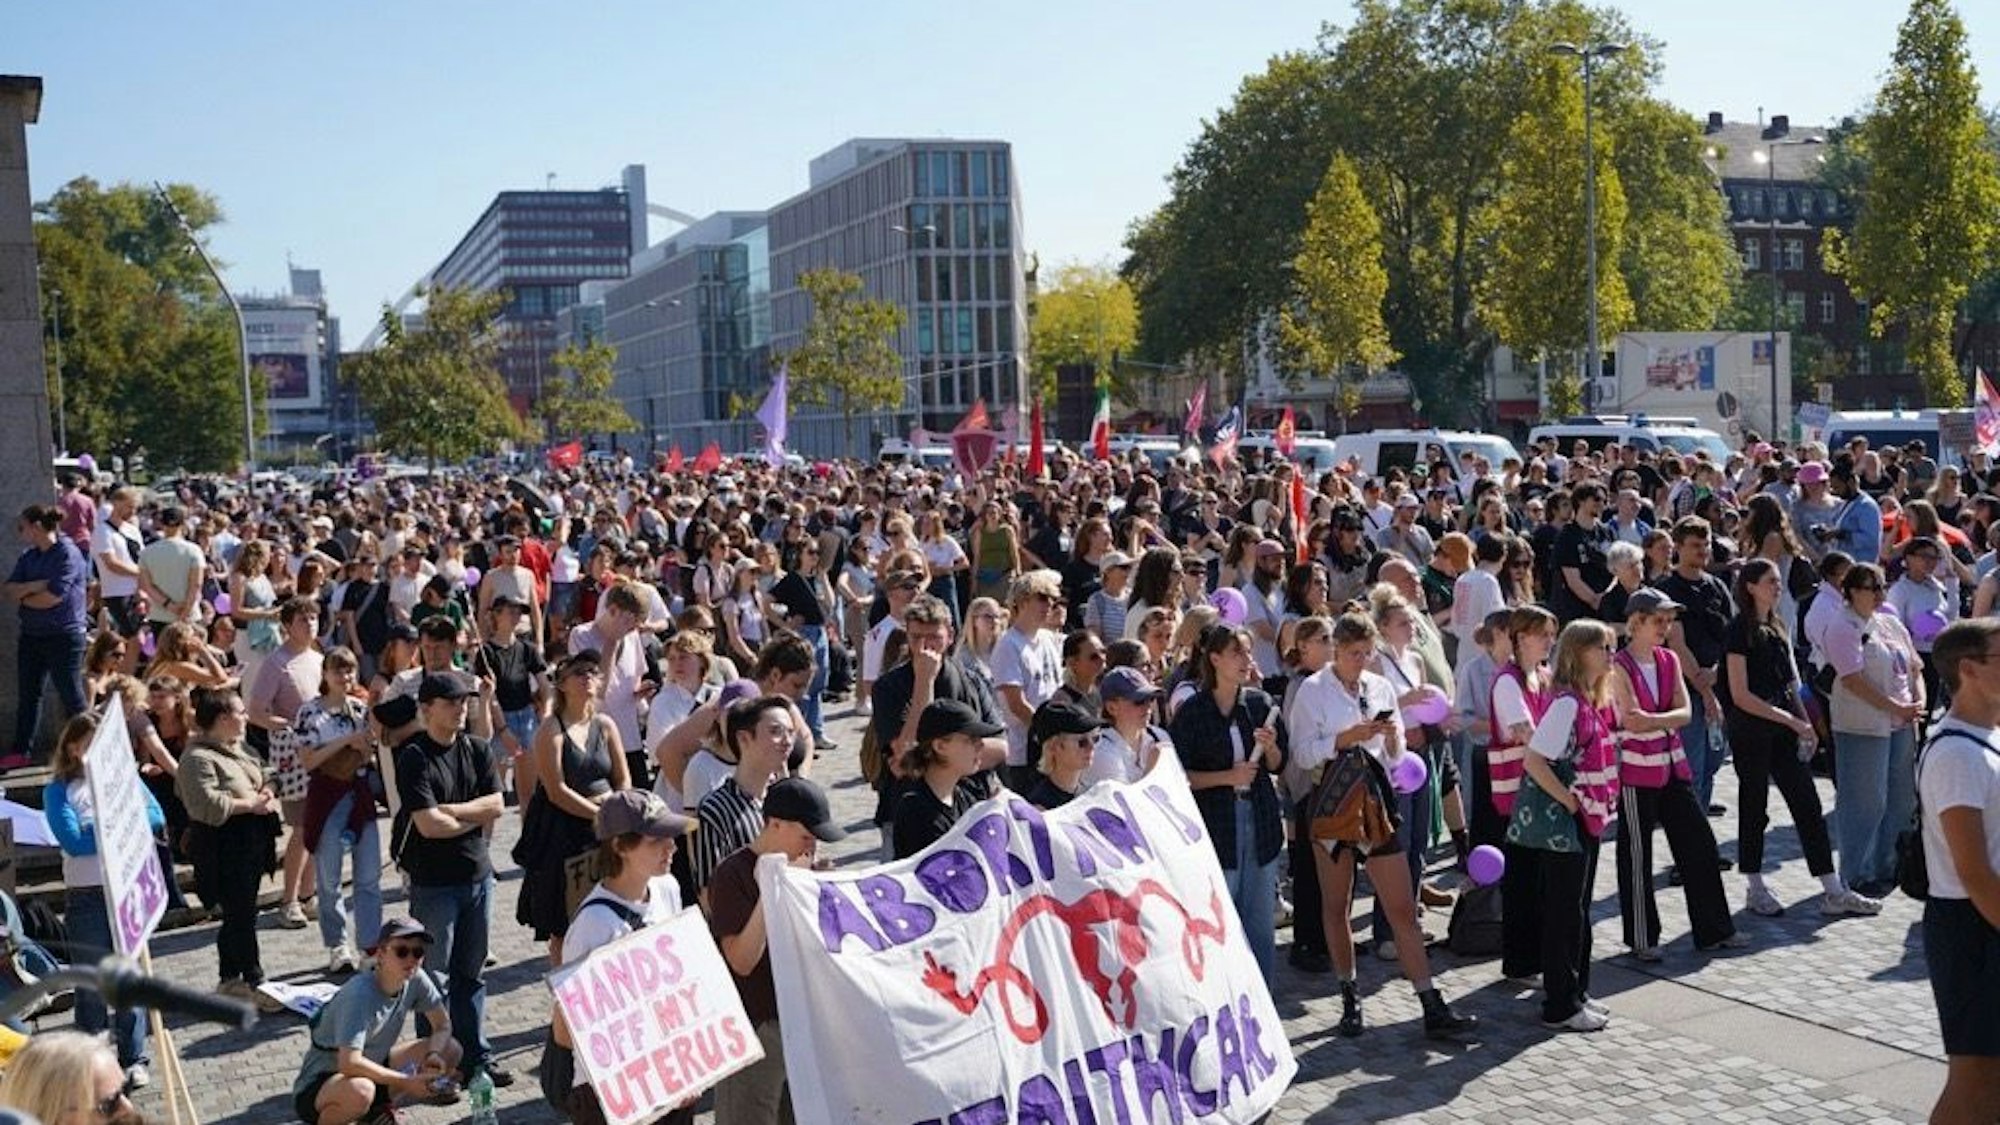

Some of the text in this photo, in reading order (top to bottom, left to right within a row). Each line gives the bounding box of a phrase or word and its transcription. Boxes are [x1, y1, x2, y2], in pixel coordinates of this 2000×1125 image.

[558, 934, 685, 1031] HANDS
[588, 982, 700, 1068] OFF MY
[599, 1016, 747, 1119] UTERUS
